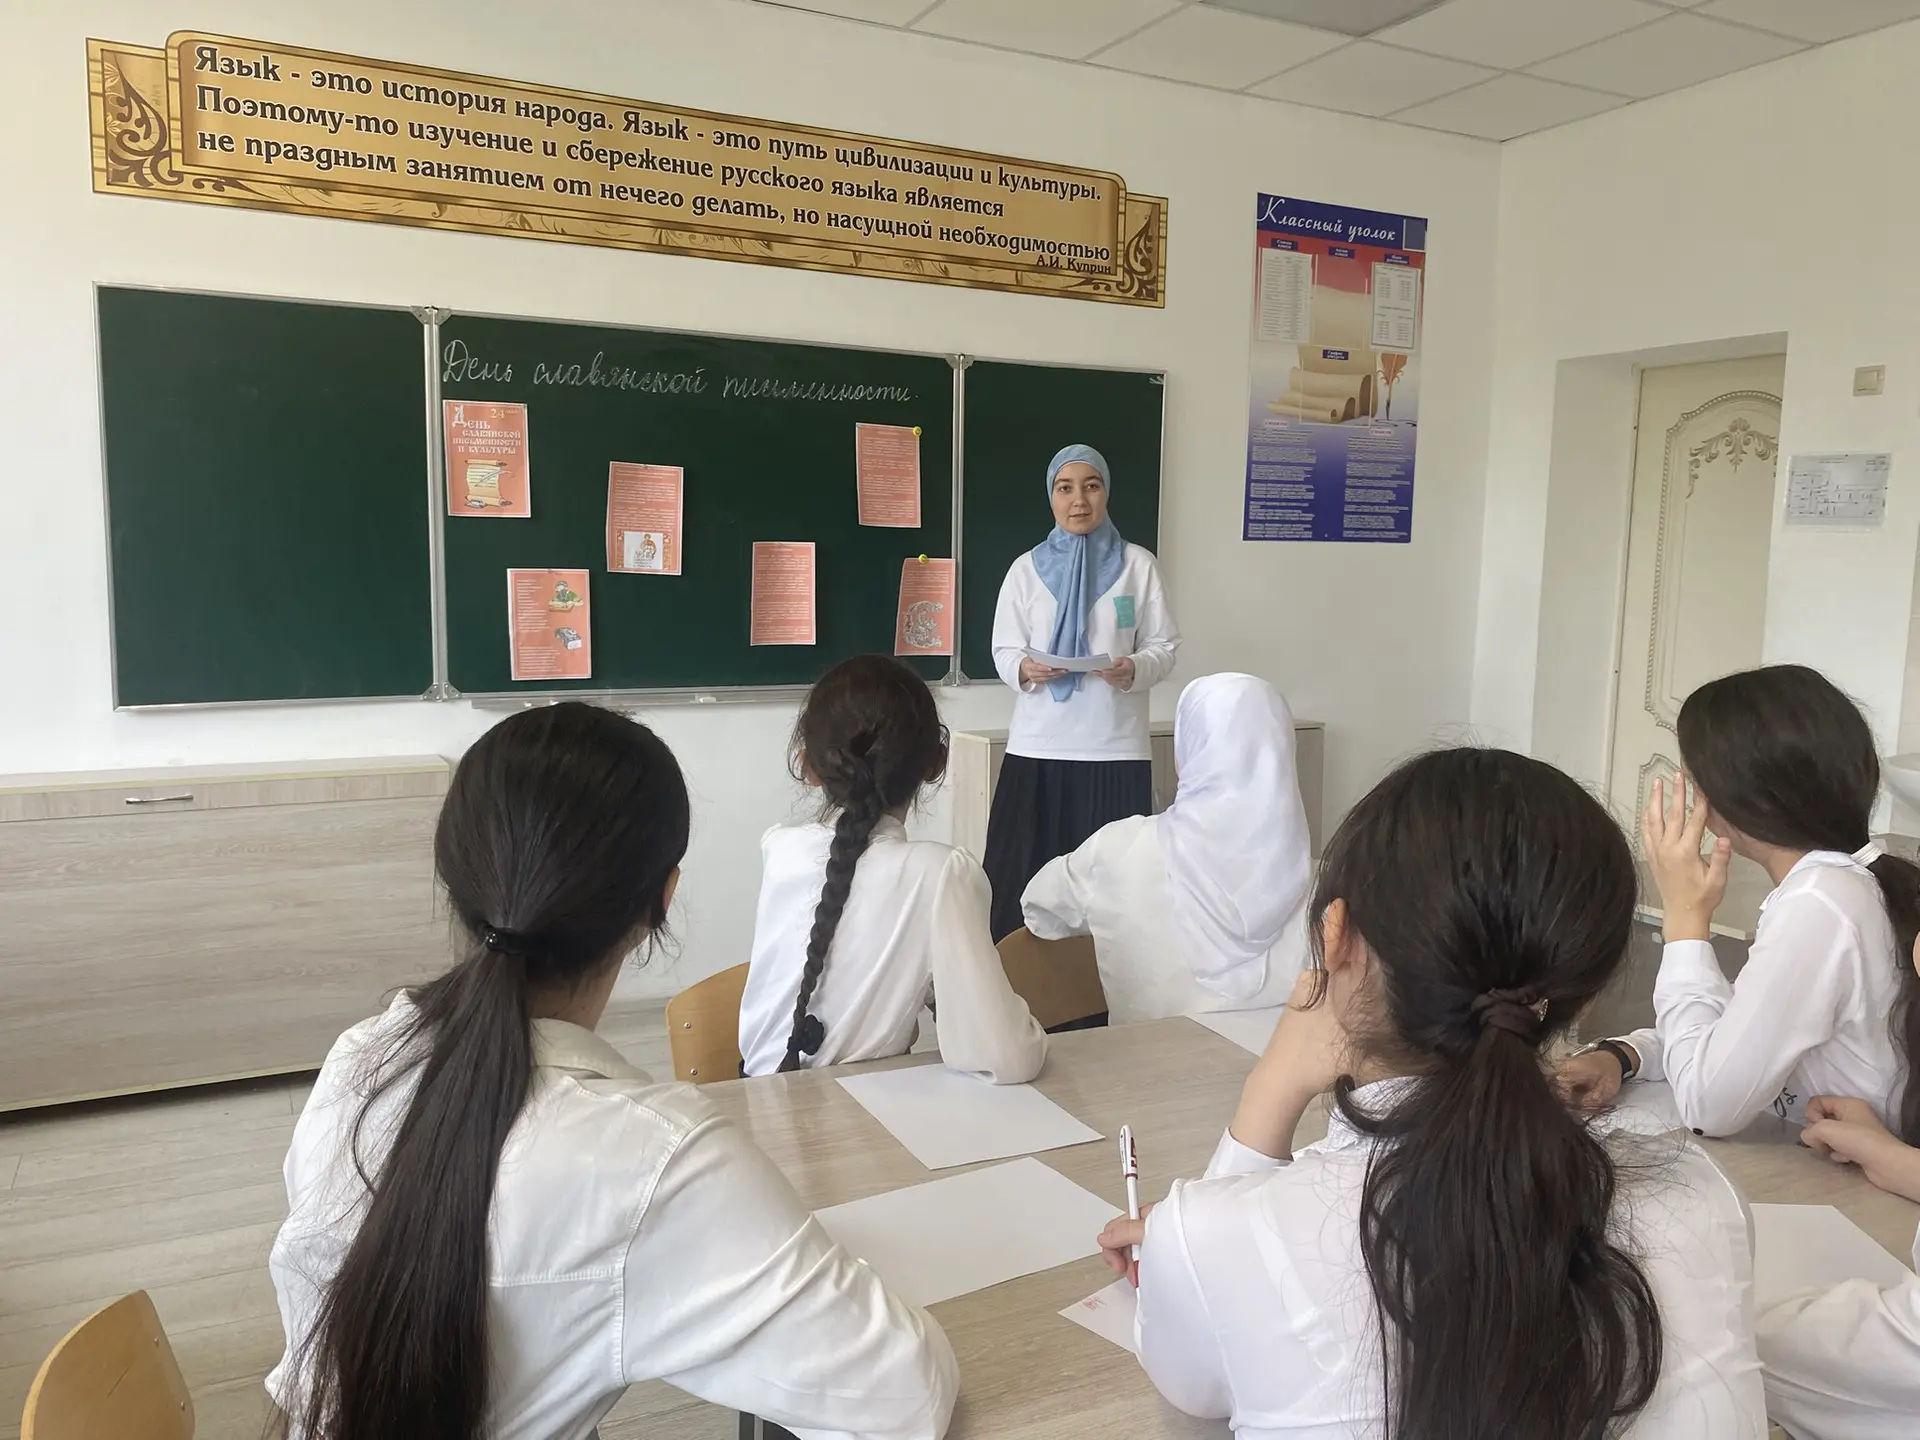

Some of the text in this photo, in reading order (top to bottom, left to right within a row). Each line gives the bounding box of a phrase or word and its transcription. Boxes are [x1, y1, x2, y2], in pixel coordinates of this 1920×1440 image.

[195, 46, 281, 82] Язык
[311, 70, 372, 95] это
[381, 80, 506, 115] история
[514, 100, 614, 133] народа.
[622, 110, 689, 141] Язык
[712, 130, 761, 151] это
[768, 138, 828, 161] путь
[834, 146, 974, 183] цивилизации
[980, 169, 992, 185] и
[998, 166, 1101, 202] культуры.
[197, 84, 1004, 218] Поэтому-то изучение и сбережение русского языка является
[198, 132, 1110, 261] не праздным занятием от нечего делать, но насущной необходимостью
[1256, 196, 1396, 243] Классный уголок
[1036, 254, 1112, 275] А.И. Куприн
[443, 339, 514, 383] День
[532, 350, 709, 394] славянской
